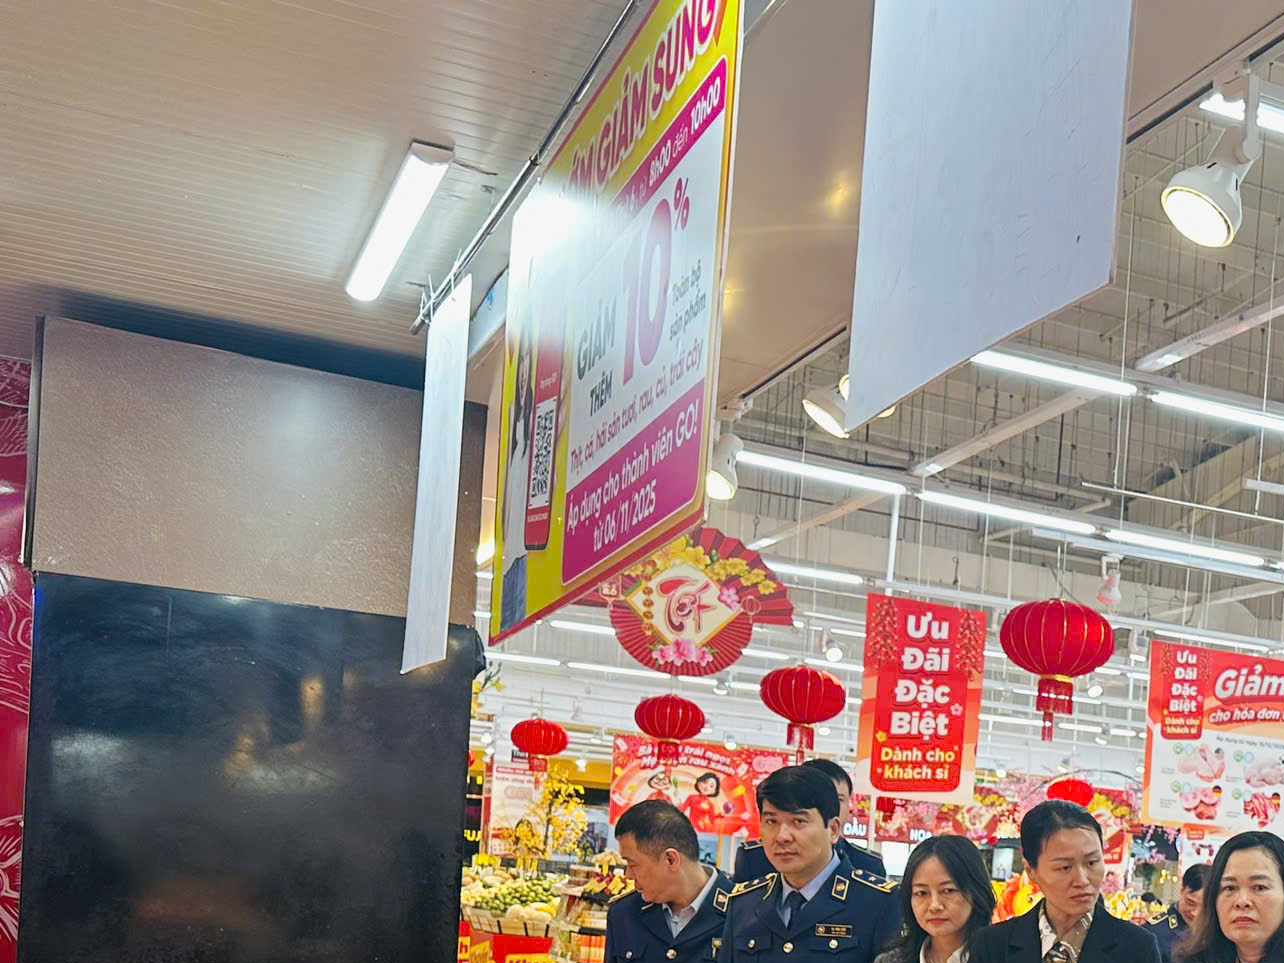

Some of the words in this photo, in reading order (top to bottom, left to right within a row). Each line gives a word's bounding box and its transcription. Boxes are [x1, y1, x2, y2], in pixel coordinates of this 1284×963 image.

[690, 76, 721, 136] 10h00
[590, 370, 613, 416] THÊM
[567, 494, 579, 535] Áp
[580, 487, 602, 526] dụng
[603, 472, 620, 504] cho
[621, 442, 650, 490] thành
[651, 425, 673, 466] viên
[675, 398, 699, 447] GO!
[906, 612, 949, 640] Ưu
[901, 646, 950, 672] Đãi
[1176, 649, 1197, 665] Ưu
[1174, 666, 1198, 680] Đãi
[894, 678, 950, 709] Đặc
[1171, 682, 1198, 698] Đặc
[1169, 698, 1197, 715] Biệt
[1208, 708, 1230, 723] cho
[1232, 706, 1255, 721] hóa
[1257, 707, 1280, 720] đơn
[890, 710, 949, 741] Biệt
[881, 746, 922, 762] Dành
[925, 747, 956, 763] cho
[884, 764, 932, 779] khách
